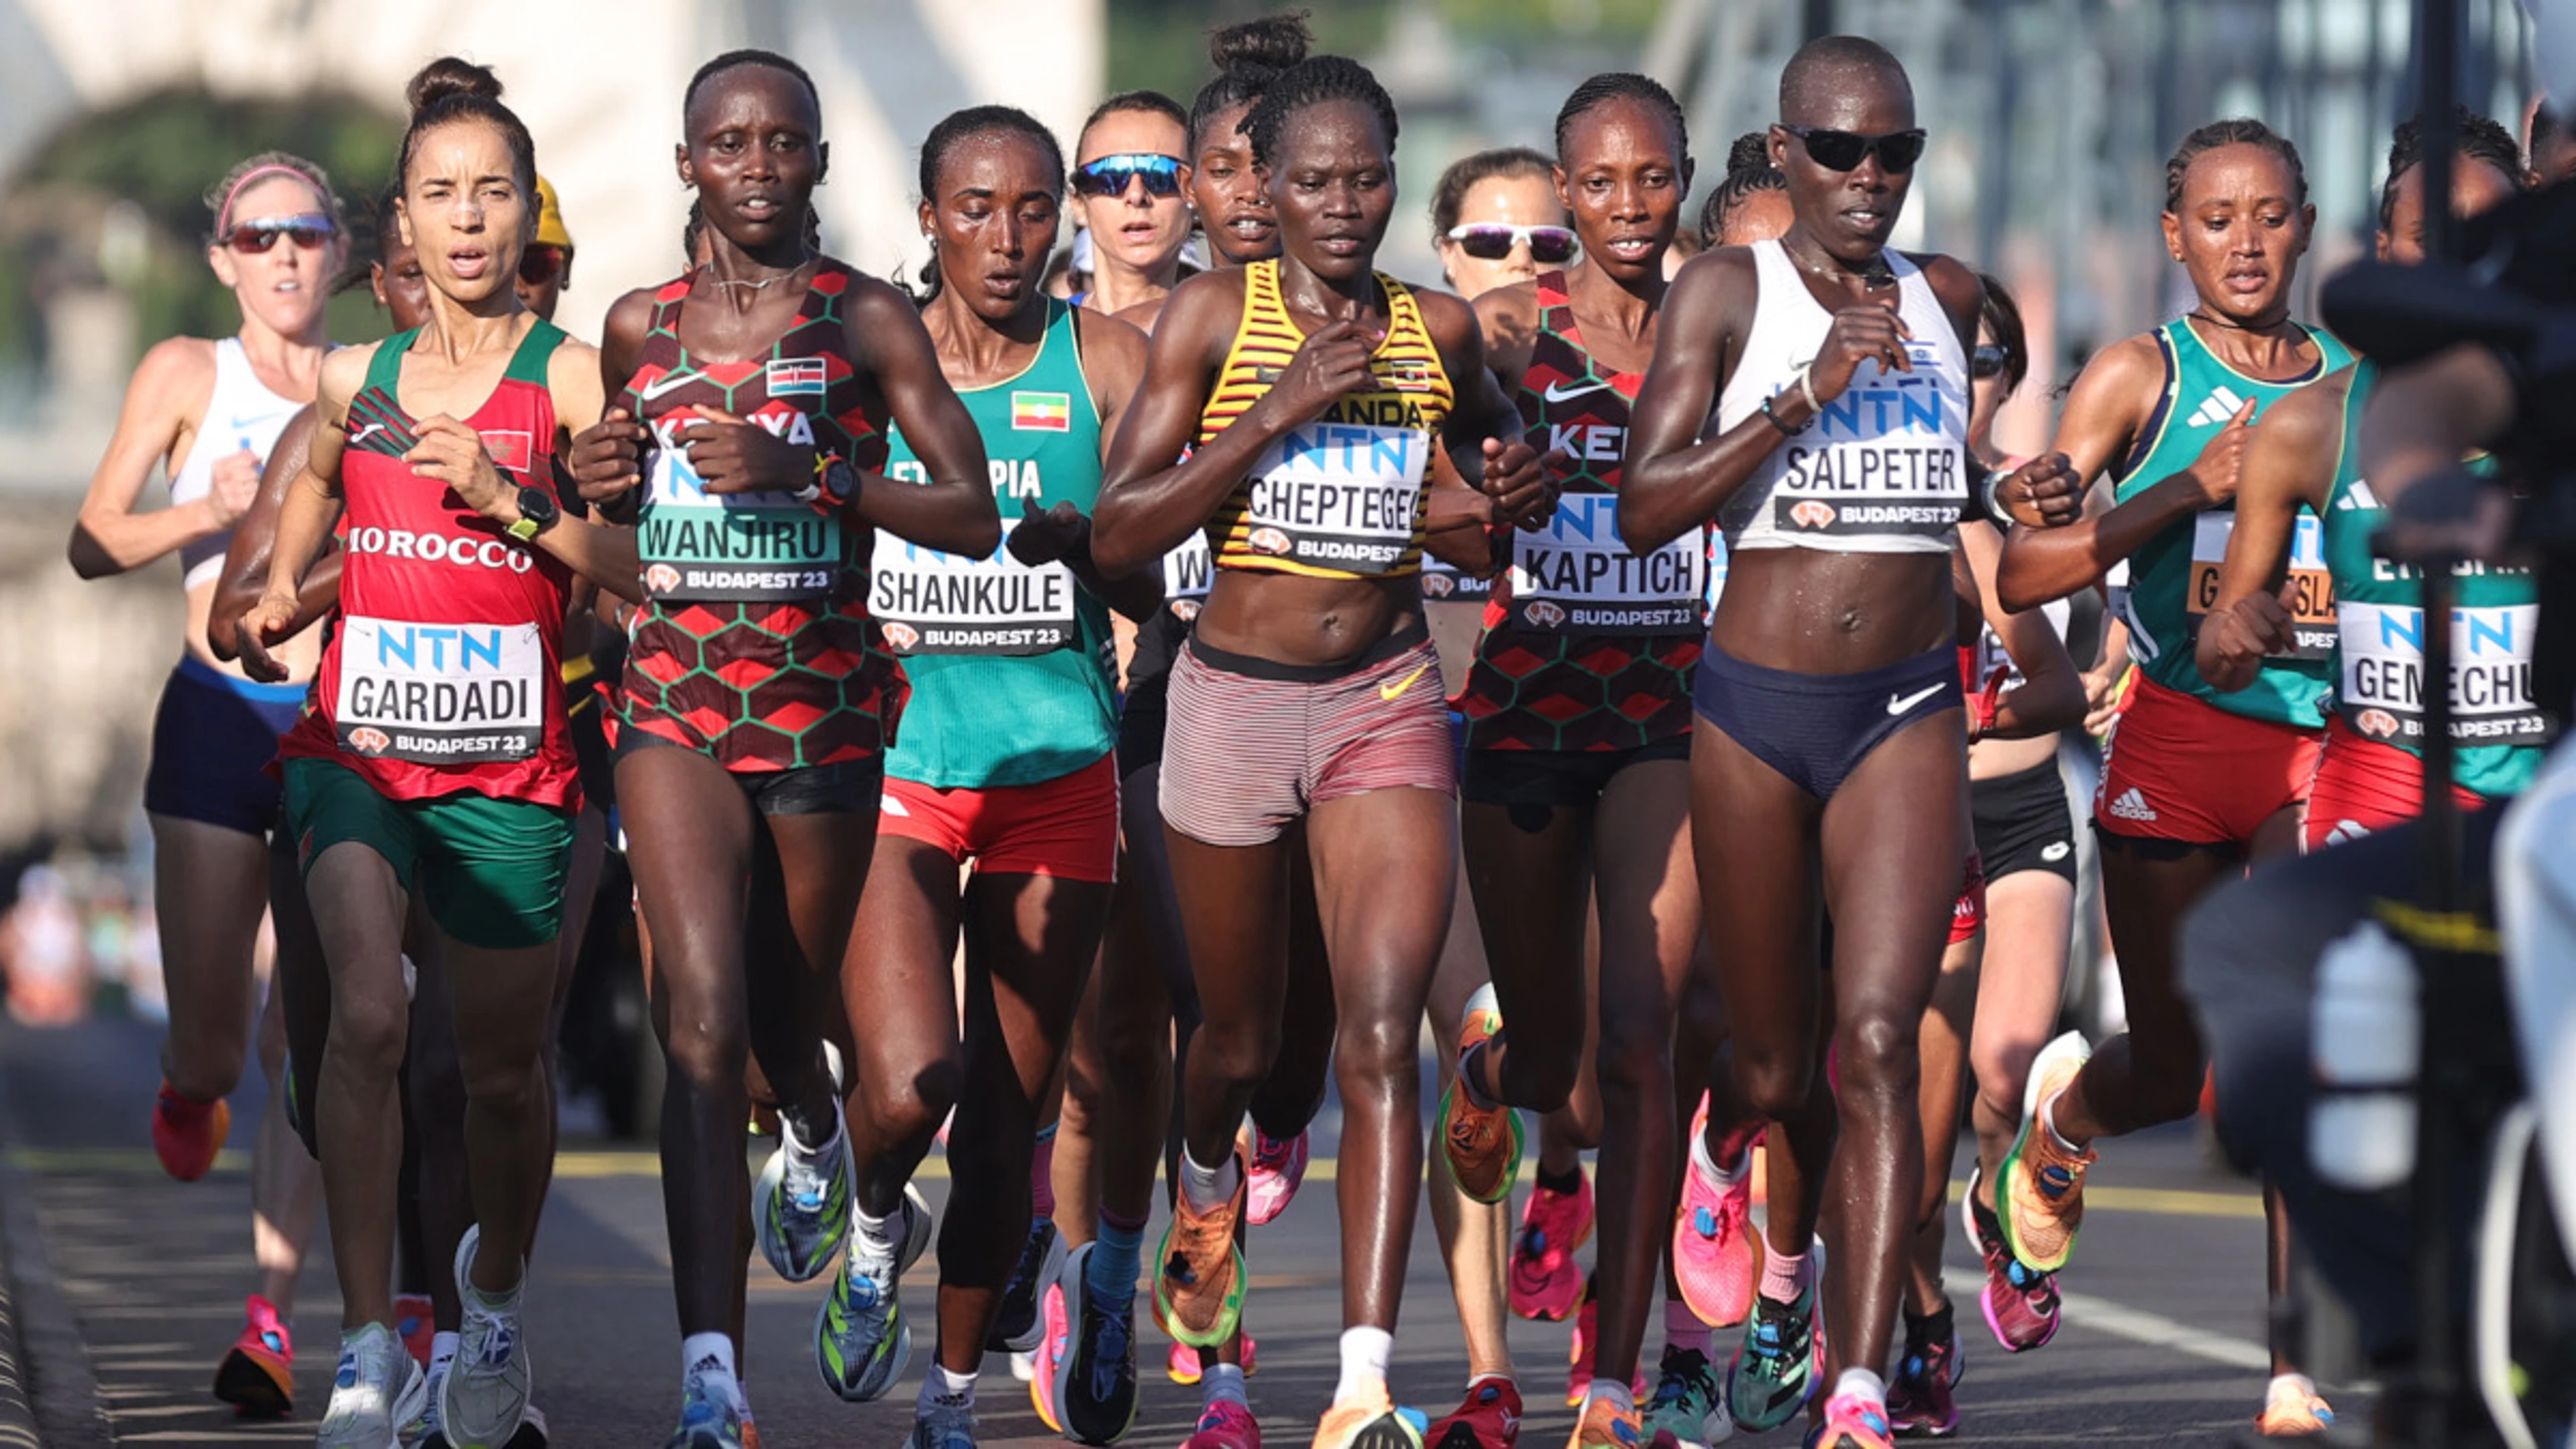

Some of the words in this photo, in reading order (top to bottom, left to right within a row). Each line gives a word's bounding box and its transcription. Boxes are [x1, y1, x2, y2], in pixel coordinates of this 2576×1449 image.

[649, 412, 814, 448] KYA
[1319, 398, 1424, 427] ANDA
[1822, 390, 1941, 437] NTN
[1283, 425, 1408, 478] NTN
[1786, 446, 1955, 490] SALPETER
[1840, 506, 1939, 523] BUDAPEST
[645, 519, 826, 559] WANJIRU
[1297, 540, 1402, 562] BUDAPEST
[687, 571, 800, 588] BUDAPEST
[803, 572, 827, 586] 23
[1525, 549, 1692, 593] KAPTICH
[877, 570, 1061, 614] SHANKULE
[1572, 609, 1671, 626] BUDAPEST
[1673, 608, 1690, 623] 23
[2379, 610, 2513, 655] NN
[378, 625, 500, 672] NTN
[925, 630, 1034, 645] BUDAPEST
[1036, 629, 1060, 644] 23
[352, 676, 527, 722] GARDADI
[396, 735, 500, 753] BUDAPEST
[502, 735, 527, 750] 23
[2403, 718, 2516, 737] BAPEST
[2518, 716, 2545, 733] 23
